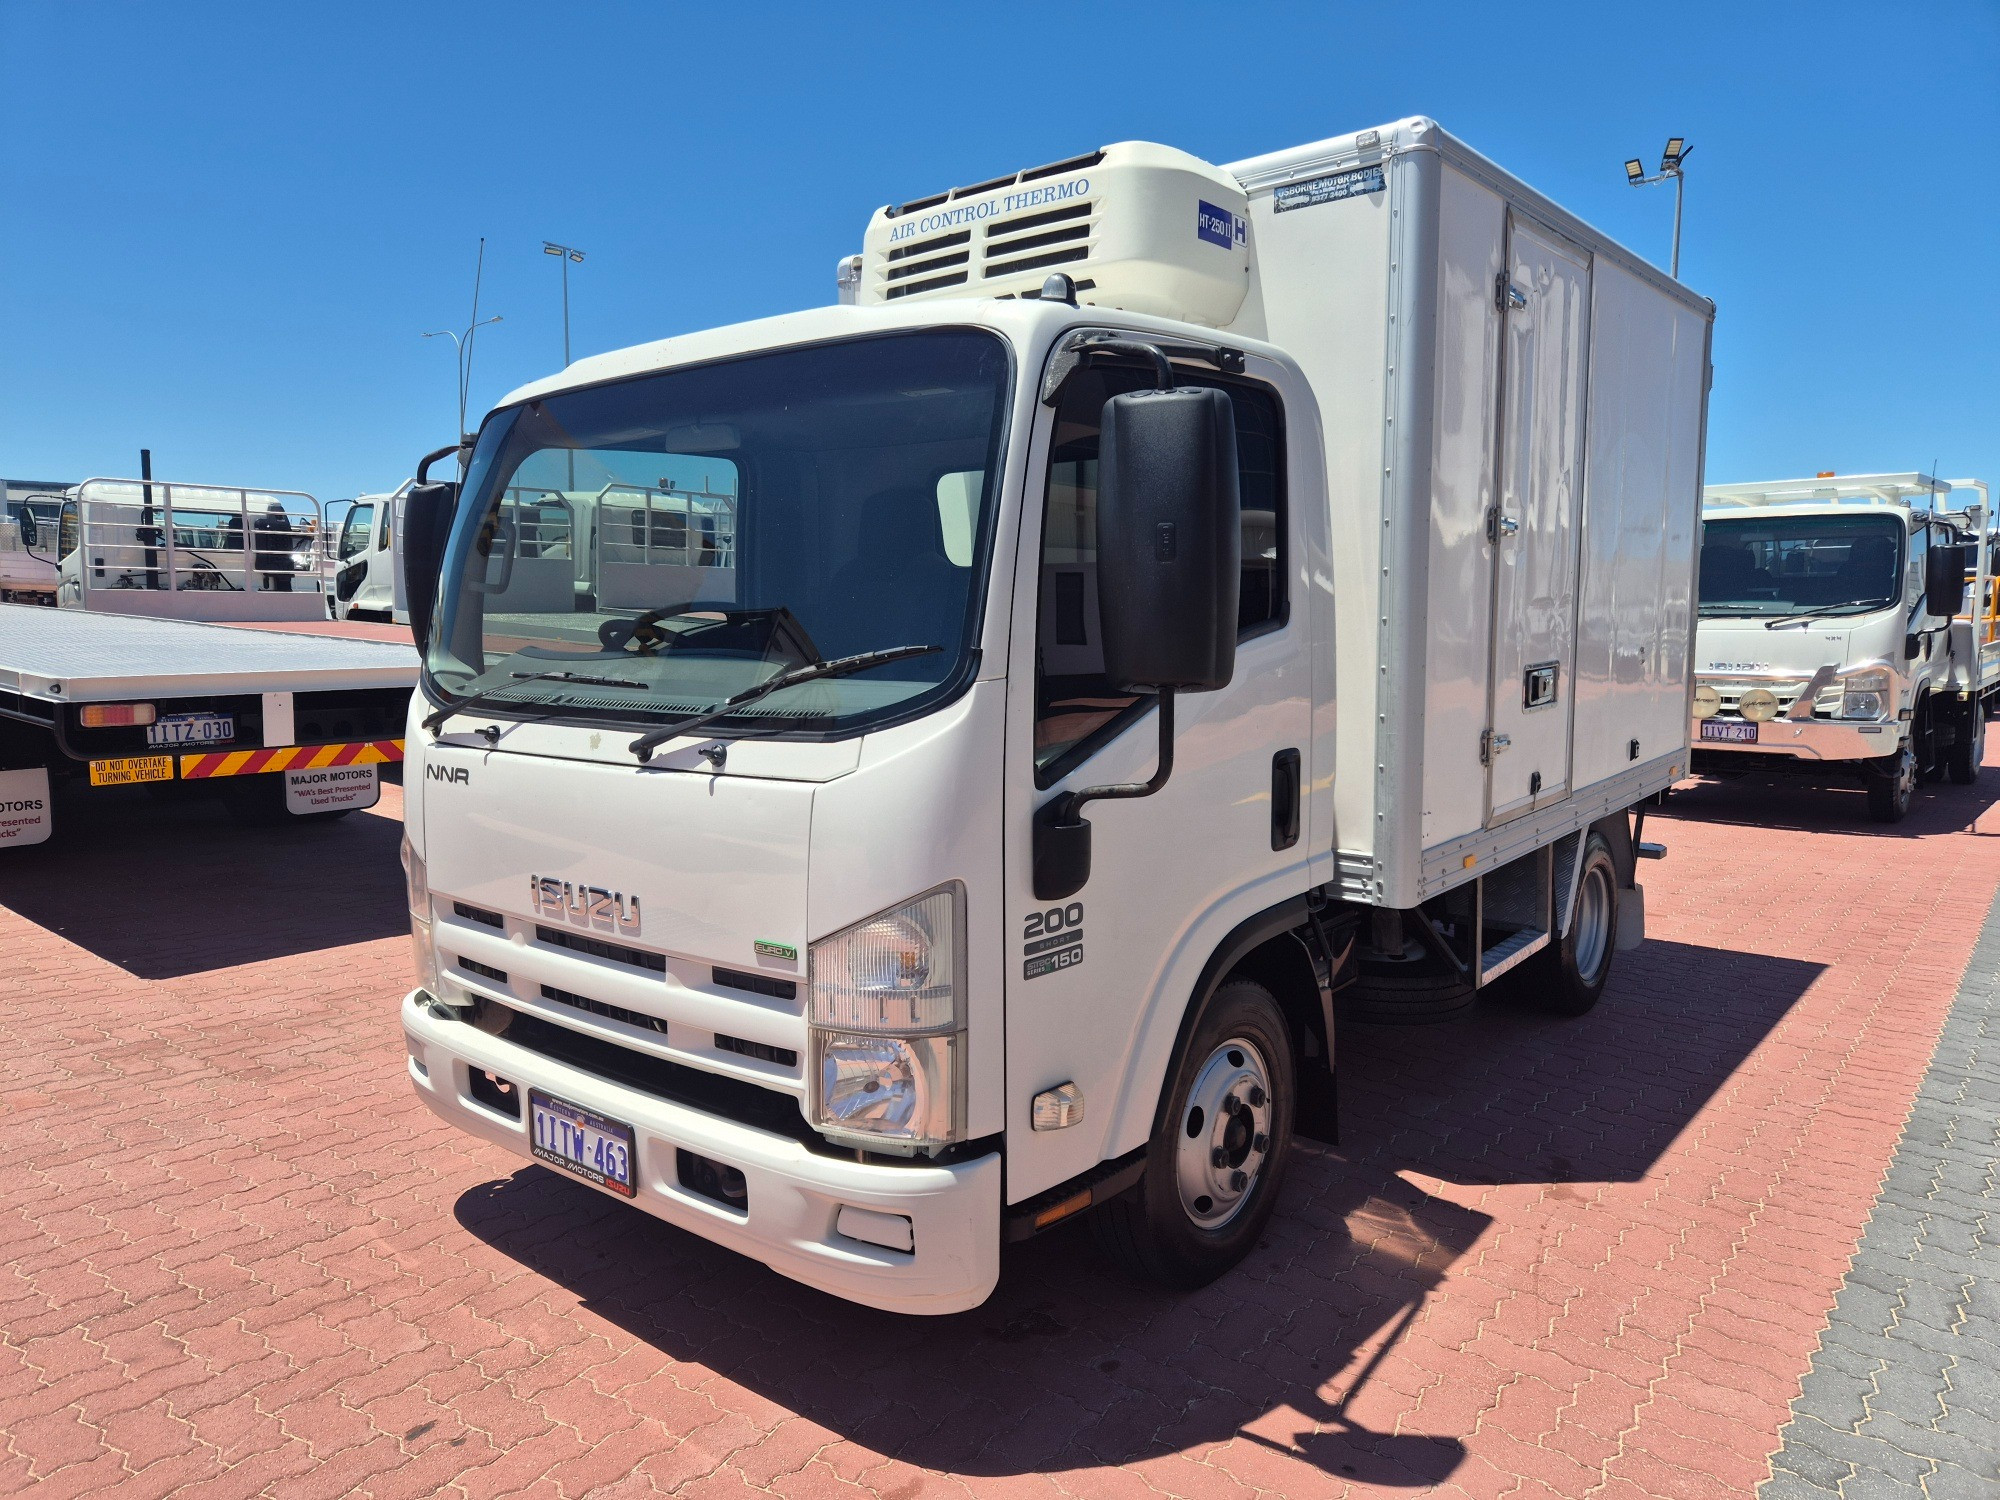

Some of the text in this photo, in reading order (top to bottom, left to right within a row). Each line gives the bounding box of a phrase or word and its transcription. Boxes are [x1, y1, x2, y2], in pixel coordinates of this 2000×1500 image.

[1319, 174, 1350, 188] MOTOR
[1351, 167, 1384, 181] BODIES
[889, 178, 1090, 242] AIR CONTROL THERMO
[1200, 212, 1225, 236] HT-250
[95, 757, 167, 772] DO NOT OVERTAKE
[98, 768, 166, 784] TURNING VEHICLE
[291, 769, 373, 785] MAJOR MOTORS
[427, 763, 469, 785] NNR
[317, 786, 334, 795] Best
[335, 783, 371, 793] Presented
[310, 796, 329, 805] Used
[531, 874, 640, 928] ISUZU
[1024, 902, 1084, 940] 200
[755, 943, 792, 957] EURO V
[1039, 935, 1071, 949] SHORT
[1051, 948, 1082, 969] 150
[1026, 966, 1046, 976] SERIES
[589, 1119, 614, 1134] AUSTRALIA
[533, 1148, 631, 1195] MAJOR MOTORS ISUZU
